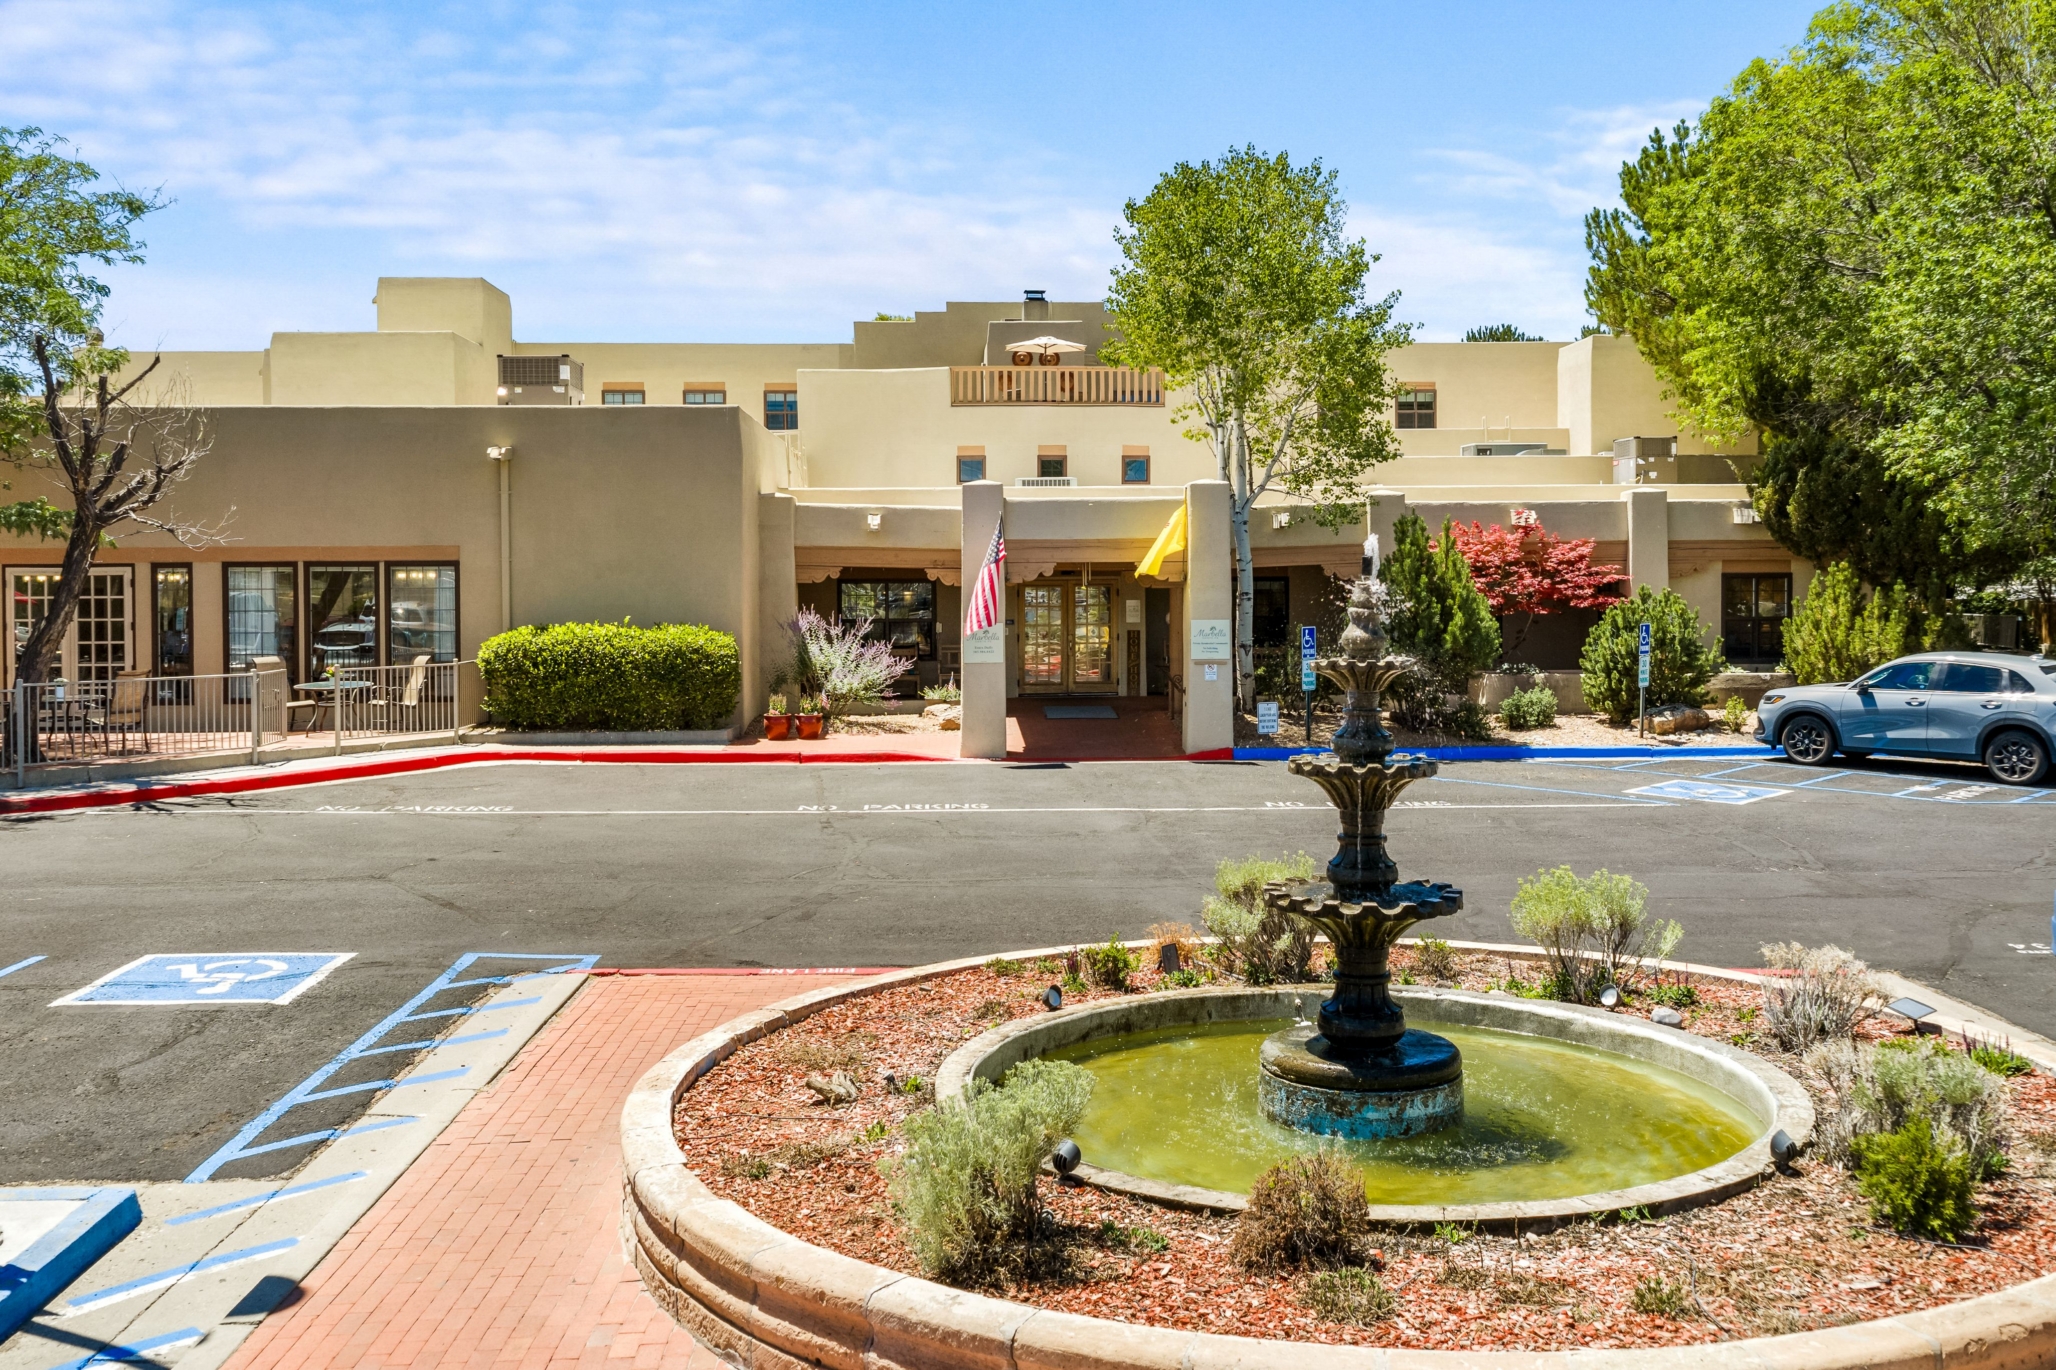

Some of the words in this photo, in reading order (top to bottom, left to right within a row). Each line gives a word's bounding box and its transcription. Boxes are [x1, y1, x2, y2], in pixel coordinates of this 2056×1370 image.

[966, 632, 1000, 642] Marbella
[1194, 629, 1227, 638] Marbella
[1130, 631, 1138, 660] HOME
[1130, 666, 1138, 696] HOME
[863, 803, 989, 811] PARKING
